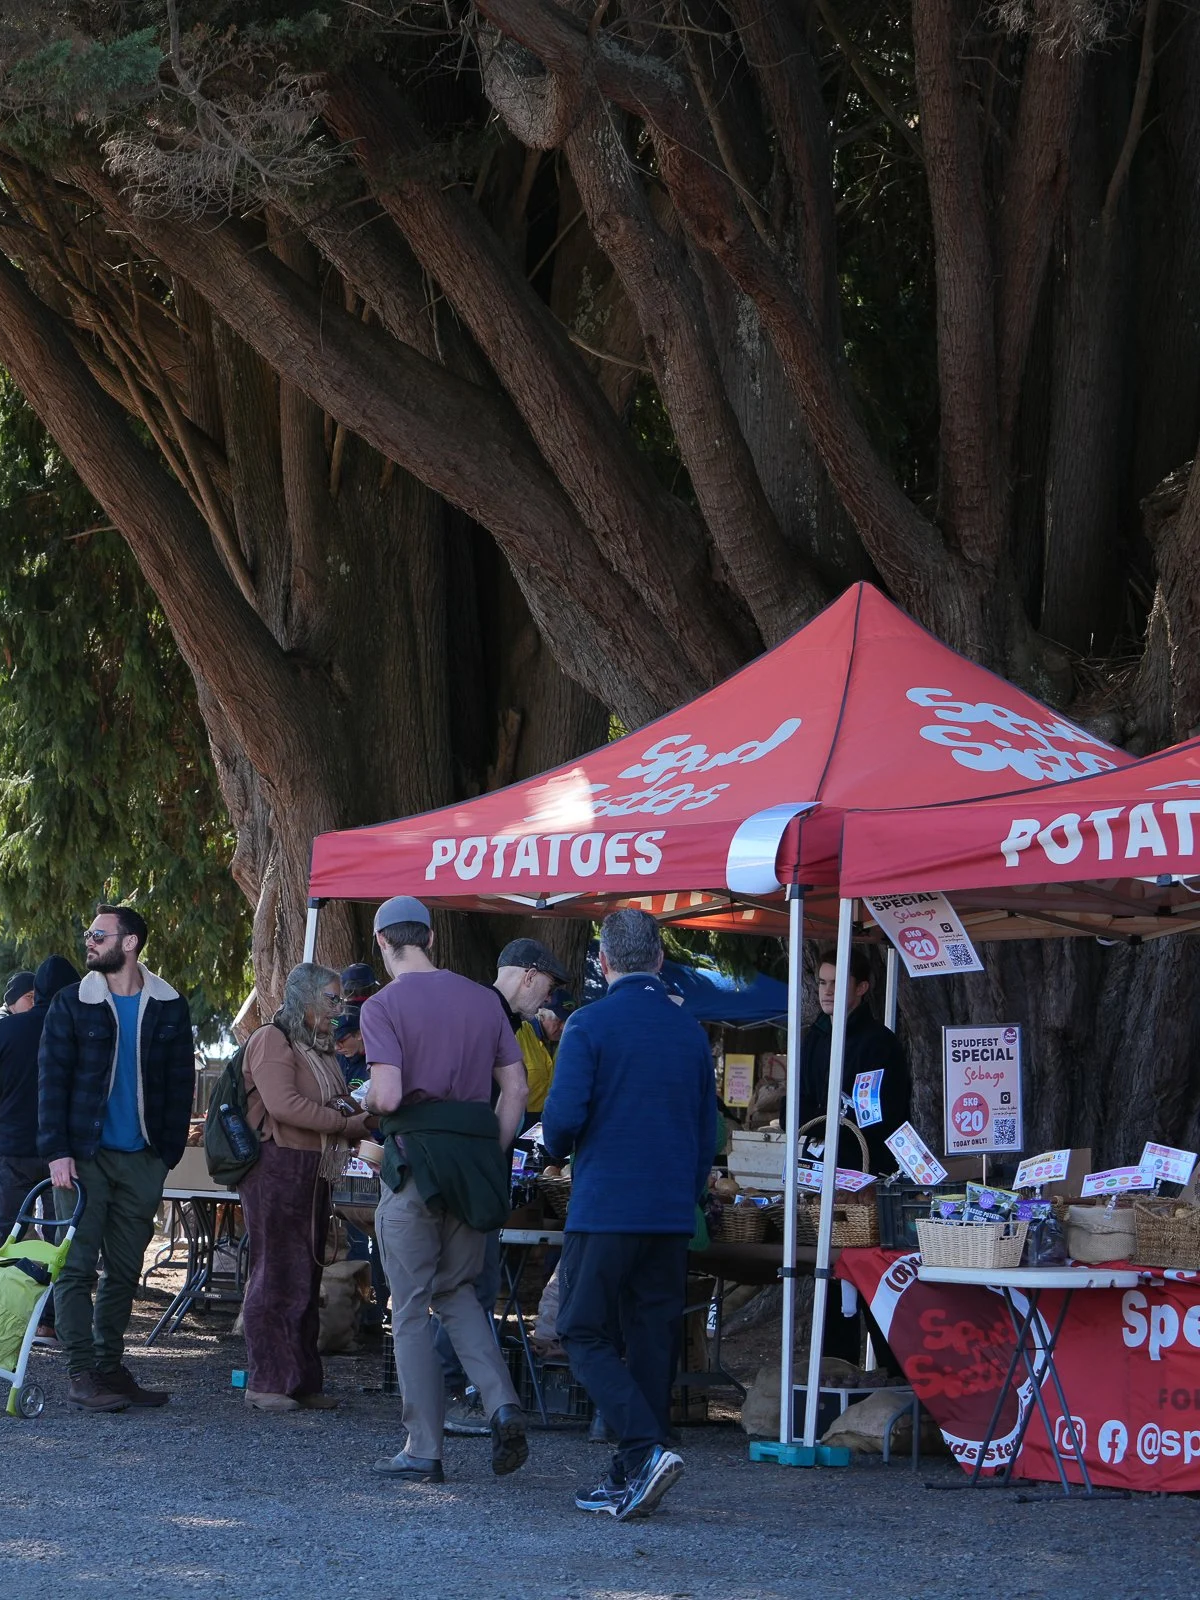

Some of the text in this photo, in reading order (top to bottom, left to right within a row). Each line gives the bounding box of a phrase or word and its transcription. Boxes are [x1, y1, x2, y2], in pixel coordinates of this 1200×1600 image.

[618, 717, 802, 783] Spud
[1001, 799, 1200, 868] POTAT
[425, 830, 666, 881] POTATOES
[872, 892, 938, 912] SPECIAL
[893, 908, 937, 924] Sebago
[904, 938, 937, 957] $20
[913, 960, 947, 971] TODAY ONLY!
[951, 1037, 999, 1048] SPUDFEST
[951, 1047, 1014, 1063] SPECIAL
[964, 1065, 1005, 1087] Sebago
[963, 1097, 979, 1107] 5KG
[955, 1110, 984, 1132] $20
[952, 1137, 988, 1148] TODAY ONLY!
[1136, 1422, 1200, 1465] @sp
